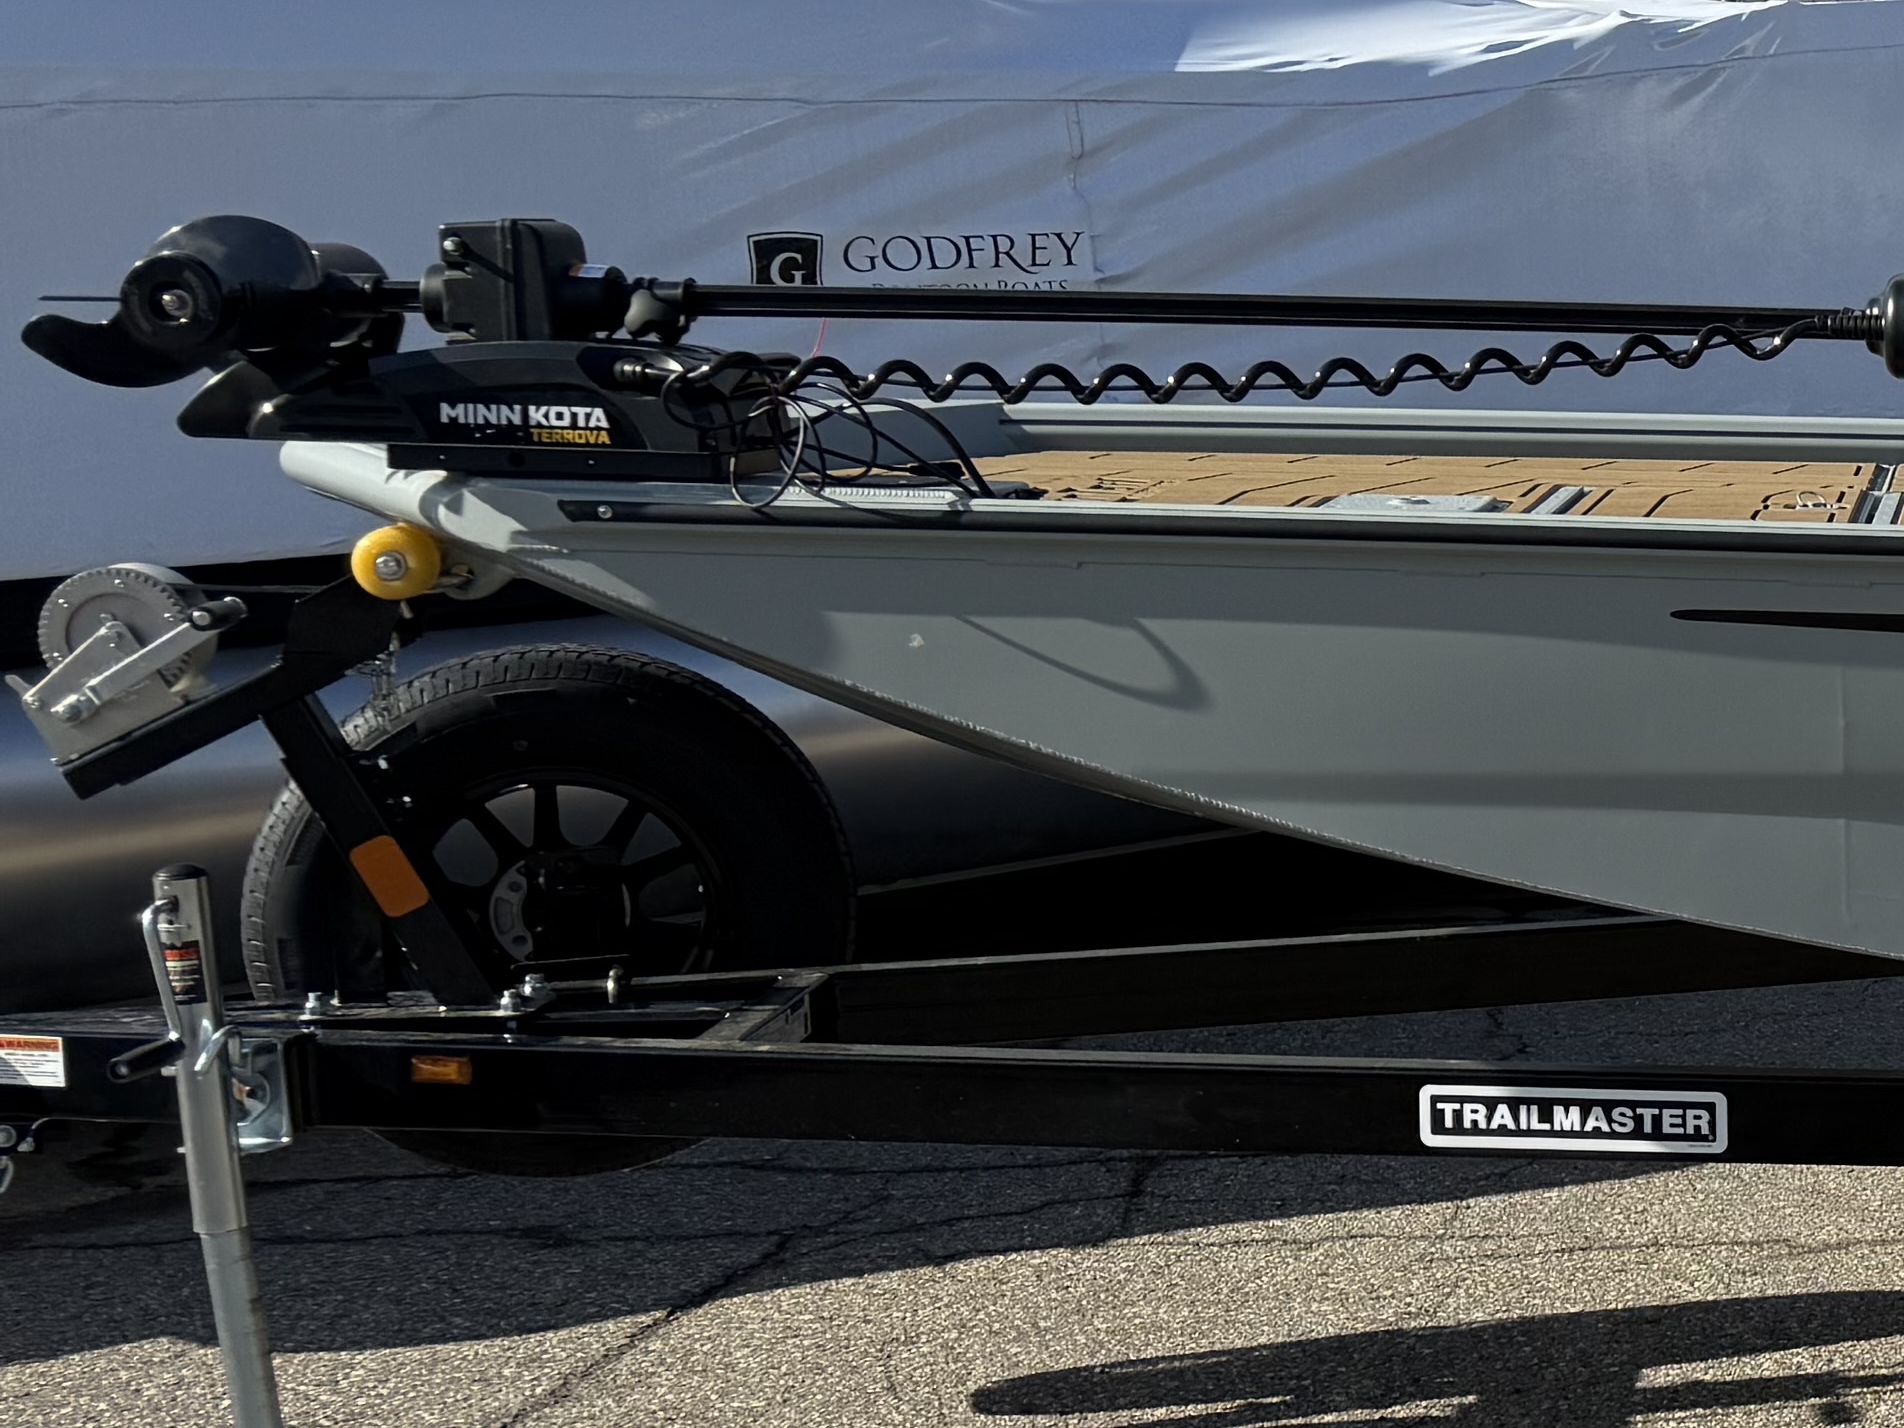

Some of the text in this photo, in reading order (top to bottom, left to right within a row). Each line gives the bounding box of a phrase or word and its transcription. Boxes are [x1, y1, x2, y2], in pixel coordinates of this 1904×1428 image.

[842, 231, 1086, 275] GODFREY
[439, 402, 612, 429] MINN KOTA
[529, 428, 612, 445] TERROVA
[1436, 1101, 1711, 1136] TRAILMASTER
